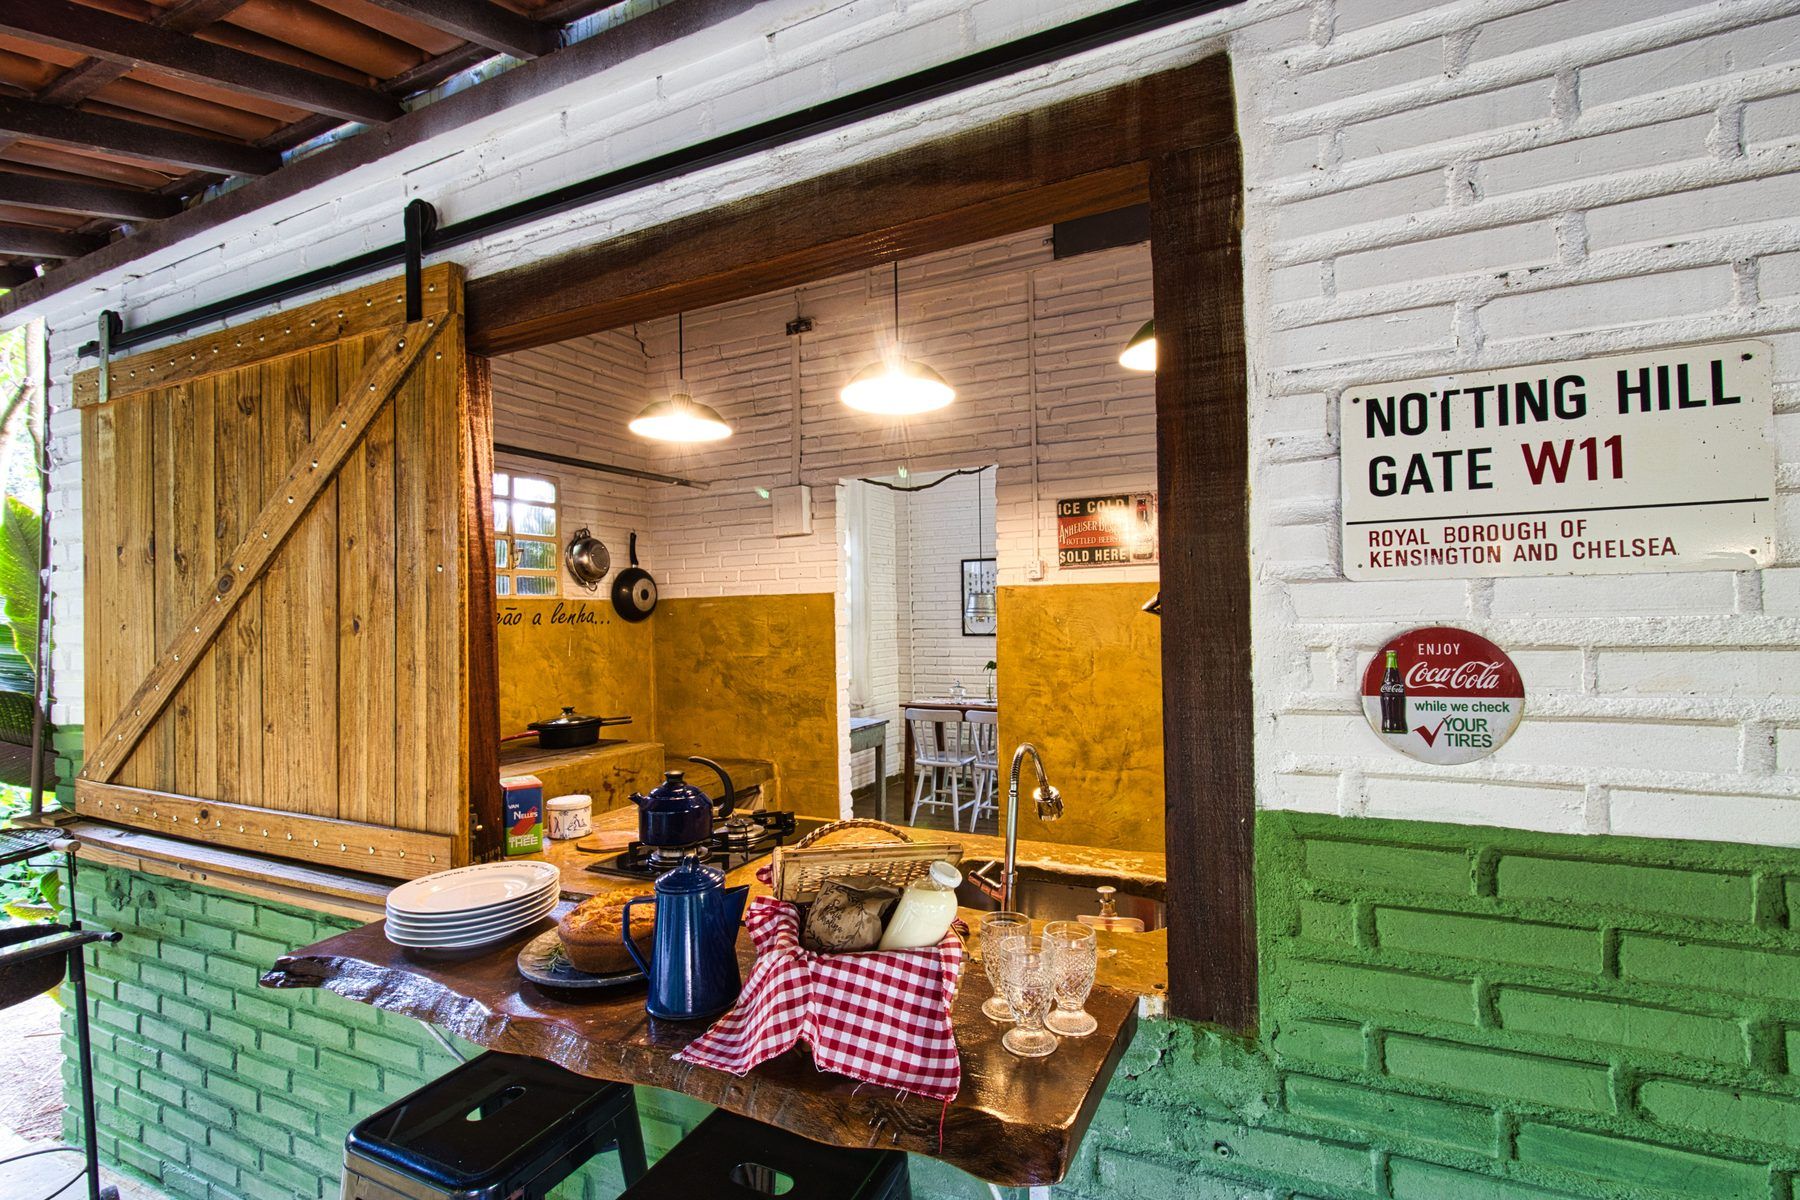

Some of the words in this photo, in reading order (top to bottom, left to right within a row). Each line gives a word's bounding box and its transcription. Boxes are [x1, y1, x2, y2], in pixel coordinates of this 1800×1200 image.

[1366, 374, 1588, 439] NOTTING
[1617, 359, 1742, 415] HILL
[1368, 447, 1494, 498] GATE
[1521, 434, 1624, 486] W11
[1058, 502, 1080, 515] ICE
[1368, 528, 1430, 548] ROYAL
[1443, 522, 1548, 545] BOROUGH
[1560, 519, 1588, 539] OF
[1060, 550, 1089, 563] SOLD
[1095, 548, 1126, 561] HERE
[1369, 545, 1501, 569] KENSINGTON
[1513, 543, 1558, 562] AND
[1572, 536, 1677, 560] CHELSEA
[532, 612, 542, 625] a
[1418, 643, 1460, 655] ENJOY
[1405, 661, 1505, 689] Coca-Cola
[1414, 700, 1447, 713] while
[1450, 703, 1469, 713] we
[1471, 701, 1510, 713] check
[1444, 717, 1488, 733] YOUR
[1444, 733, 1492, 748] TIRES
